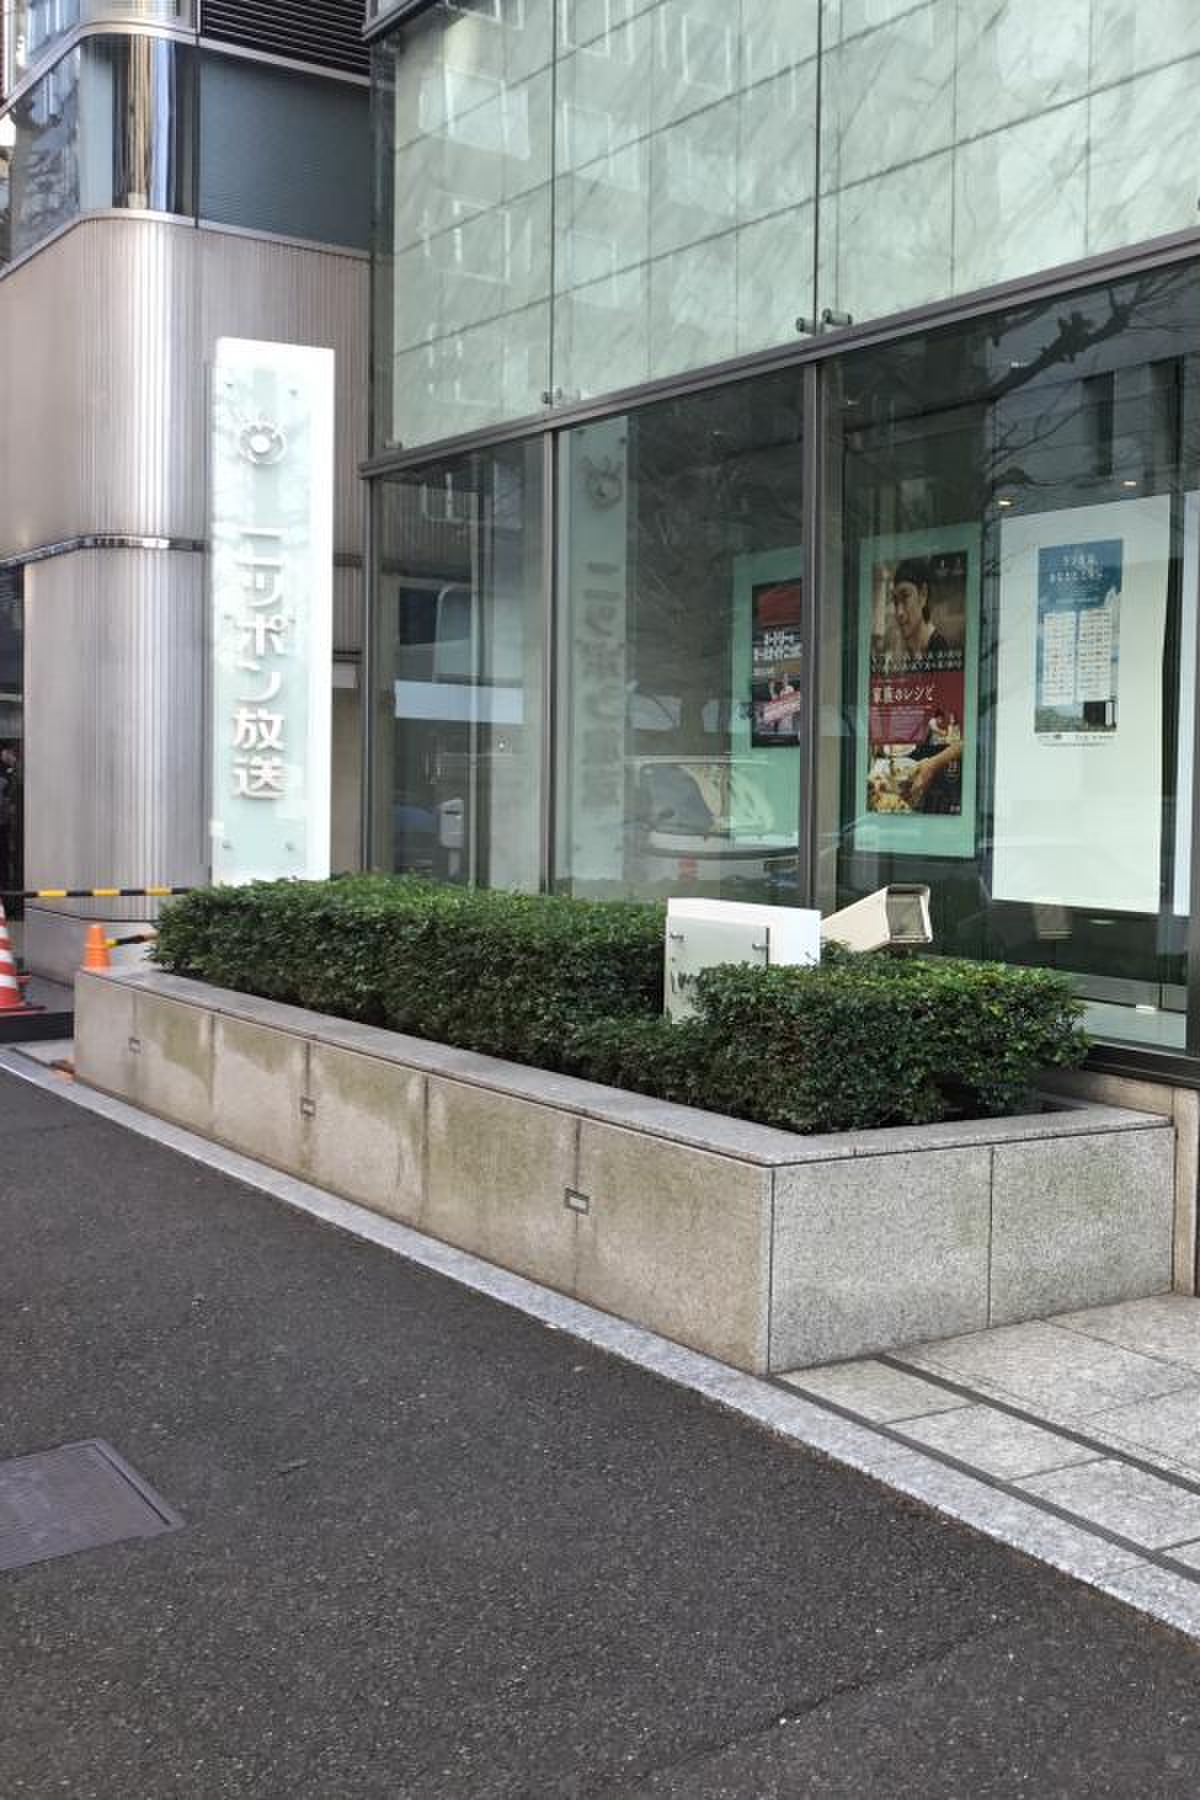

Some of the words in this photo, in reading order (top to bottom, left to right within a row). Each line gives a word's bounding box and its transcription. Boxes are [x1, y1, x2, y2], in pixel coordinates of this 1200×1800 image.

[233, 529, 288, 801] ニッポン放送
